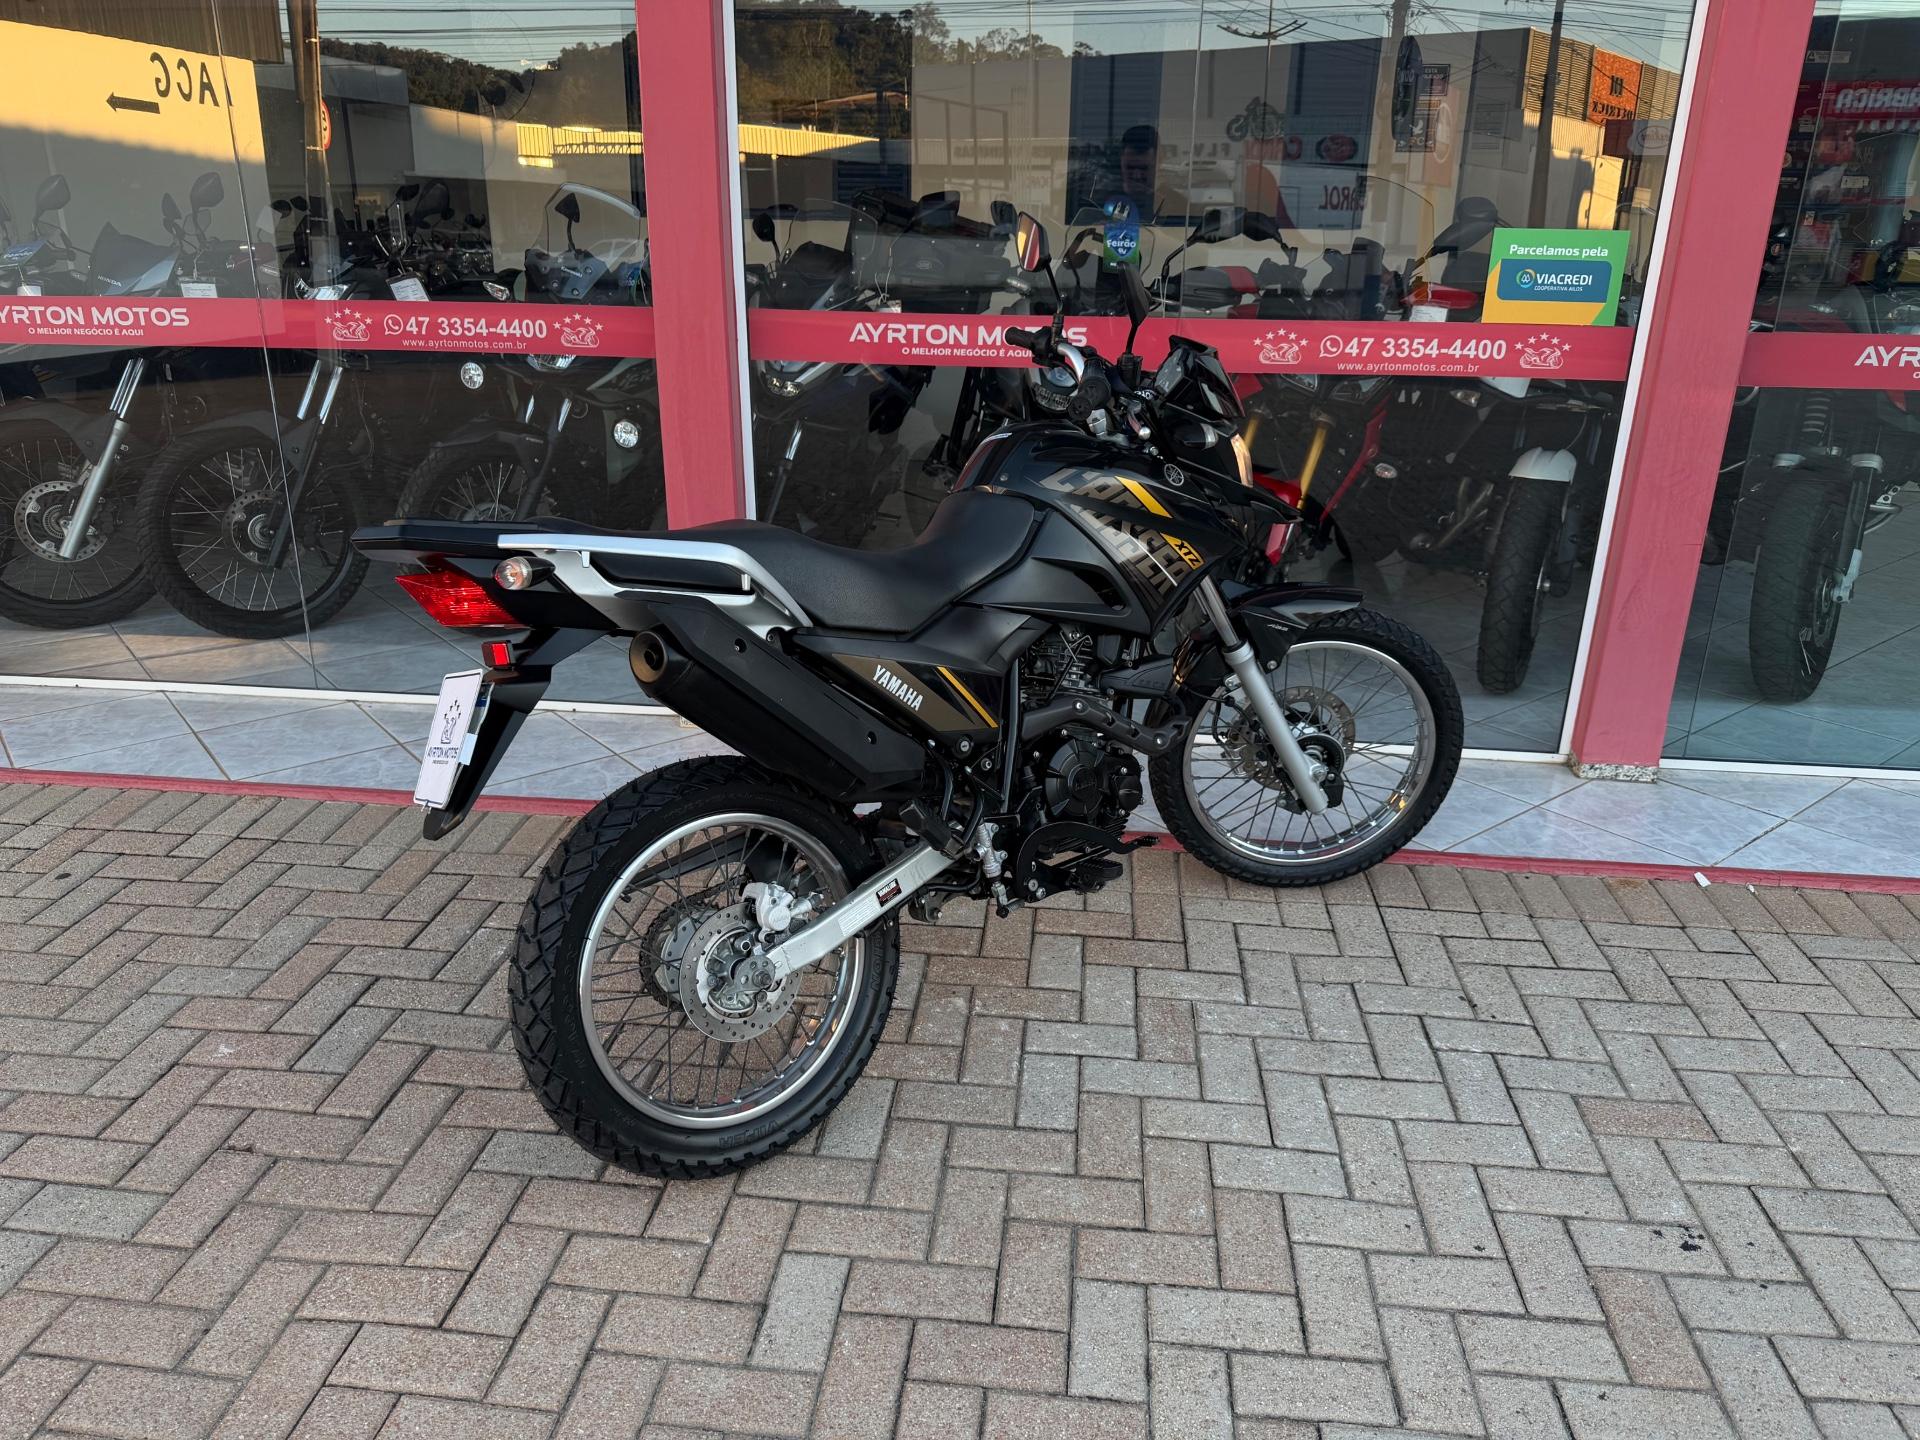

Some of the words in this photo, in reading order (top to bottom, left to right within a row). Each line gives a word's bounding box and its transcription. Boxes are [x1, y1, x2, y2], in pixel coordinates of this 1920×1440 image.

[1106, 239, 1137, 248] Feirão
[1509, 244, 1580, 257] Parcelamos
[1582, 246, 1609, 258] pela
[97, 275, 122, 288] HONDA
[1536, 273, 1593, 286] VIACREDI
[92, 306, 190, 327] MOTOS
[28, 327, 36, 335] O
[37, 327, 73, 336] MELHOR
[74, 326, 113, 337] NEGÓCIO
[115, 326, 121, 336] É
[121, 328, 144, 337] AQUI
[406, 316, 430, 335] 47
[437, 317, 547, 339] 3354-4400
[849, 322, 968, 345] AYRTON
[402, 338, 527, 350] www.ayrtonmotos.com.br
[1344, 337, 1375, 357] 47
[1381, 337, 1507, 360] 3354-4400
[902, 347, 910, 355] O
[911, 347, 952, 356] MELHOR
[953, 346, 997, 357] NEGÓCIO
[1000, 347, 1006, 357] É
[1337, 362, 1480, 373] www.ayrtonmotos.com.br
[1173, 540, 1201, 566] XTZ
[873, 664, 923, 711] YAMAHA
